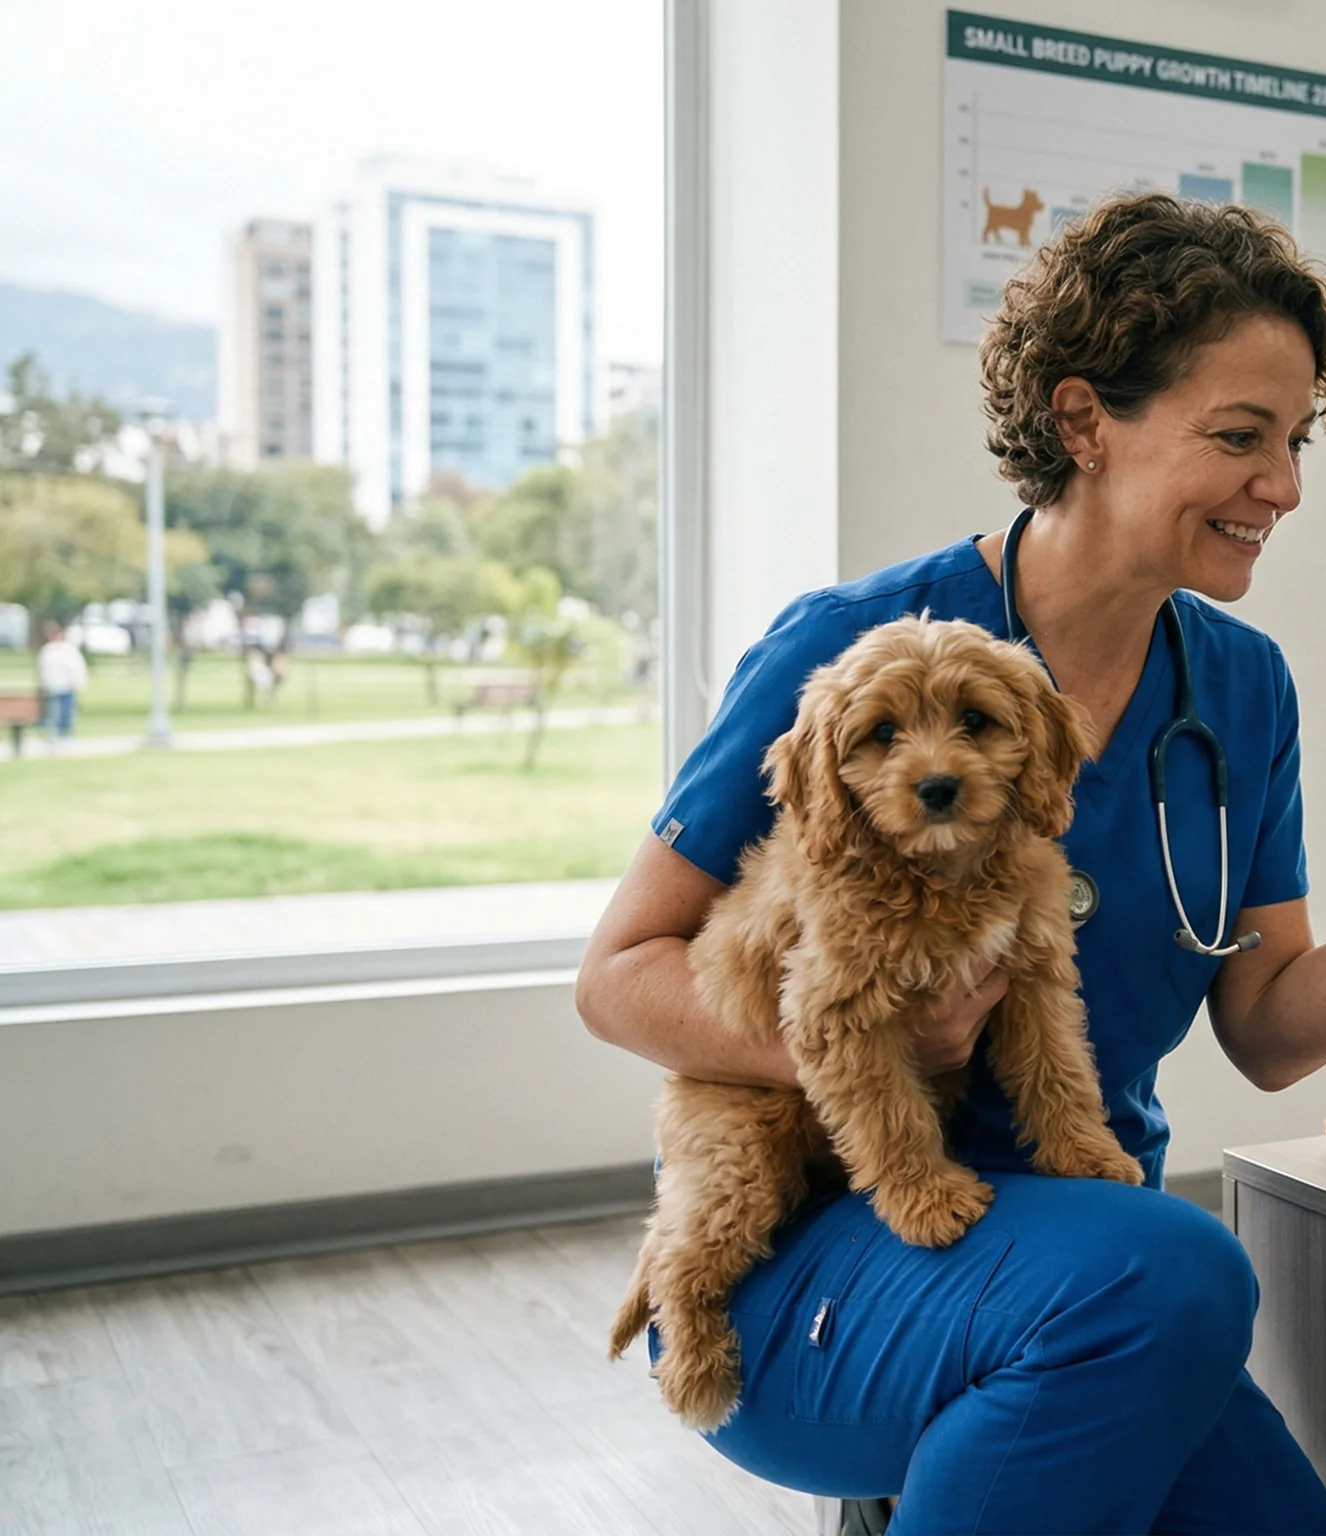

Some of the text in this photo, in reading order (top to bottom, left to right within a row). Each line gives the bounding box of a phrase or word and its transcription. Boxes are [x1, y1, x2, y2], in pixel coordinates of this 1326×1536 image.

[964, 26, 1029, 57] SMALL
[1032, 37, 1091, 67] BREED
[1094, 48, 1154, 77] PUPPY
[1156, 58, 1231, 91] GROWTH
[1234, 70, 1309, 104] TIMELINE
